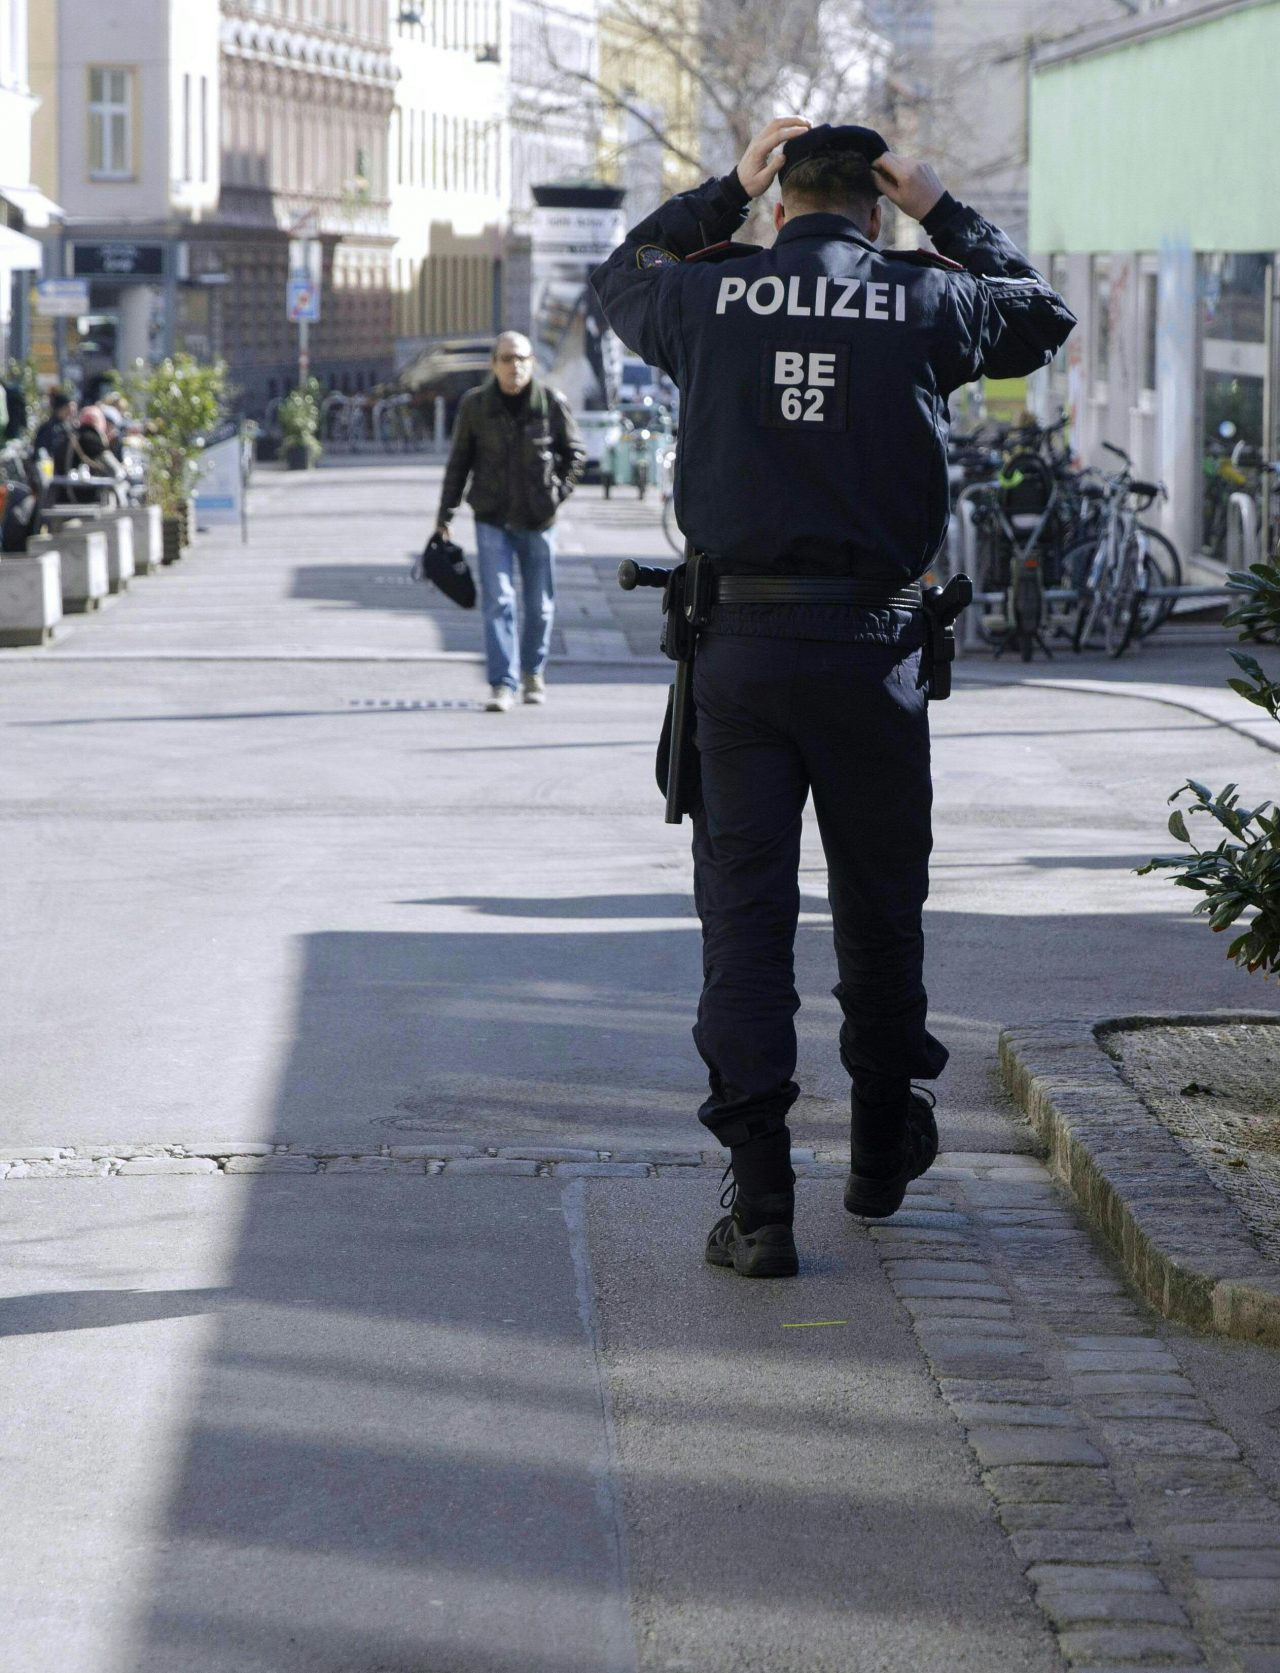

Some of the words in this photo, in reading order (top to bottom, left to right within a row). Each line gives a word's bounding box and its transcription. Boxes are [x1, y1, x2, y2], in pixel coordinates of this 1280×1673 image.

[715, 275, 906, 322] POLIZEI
[774, 350, 836, 387] BE
[780, 387, 825, 422] 62
